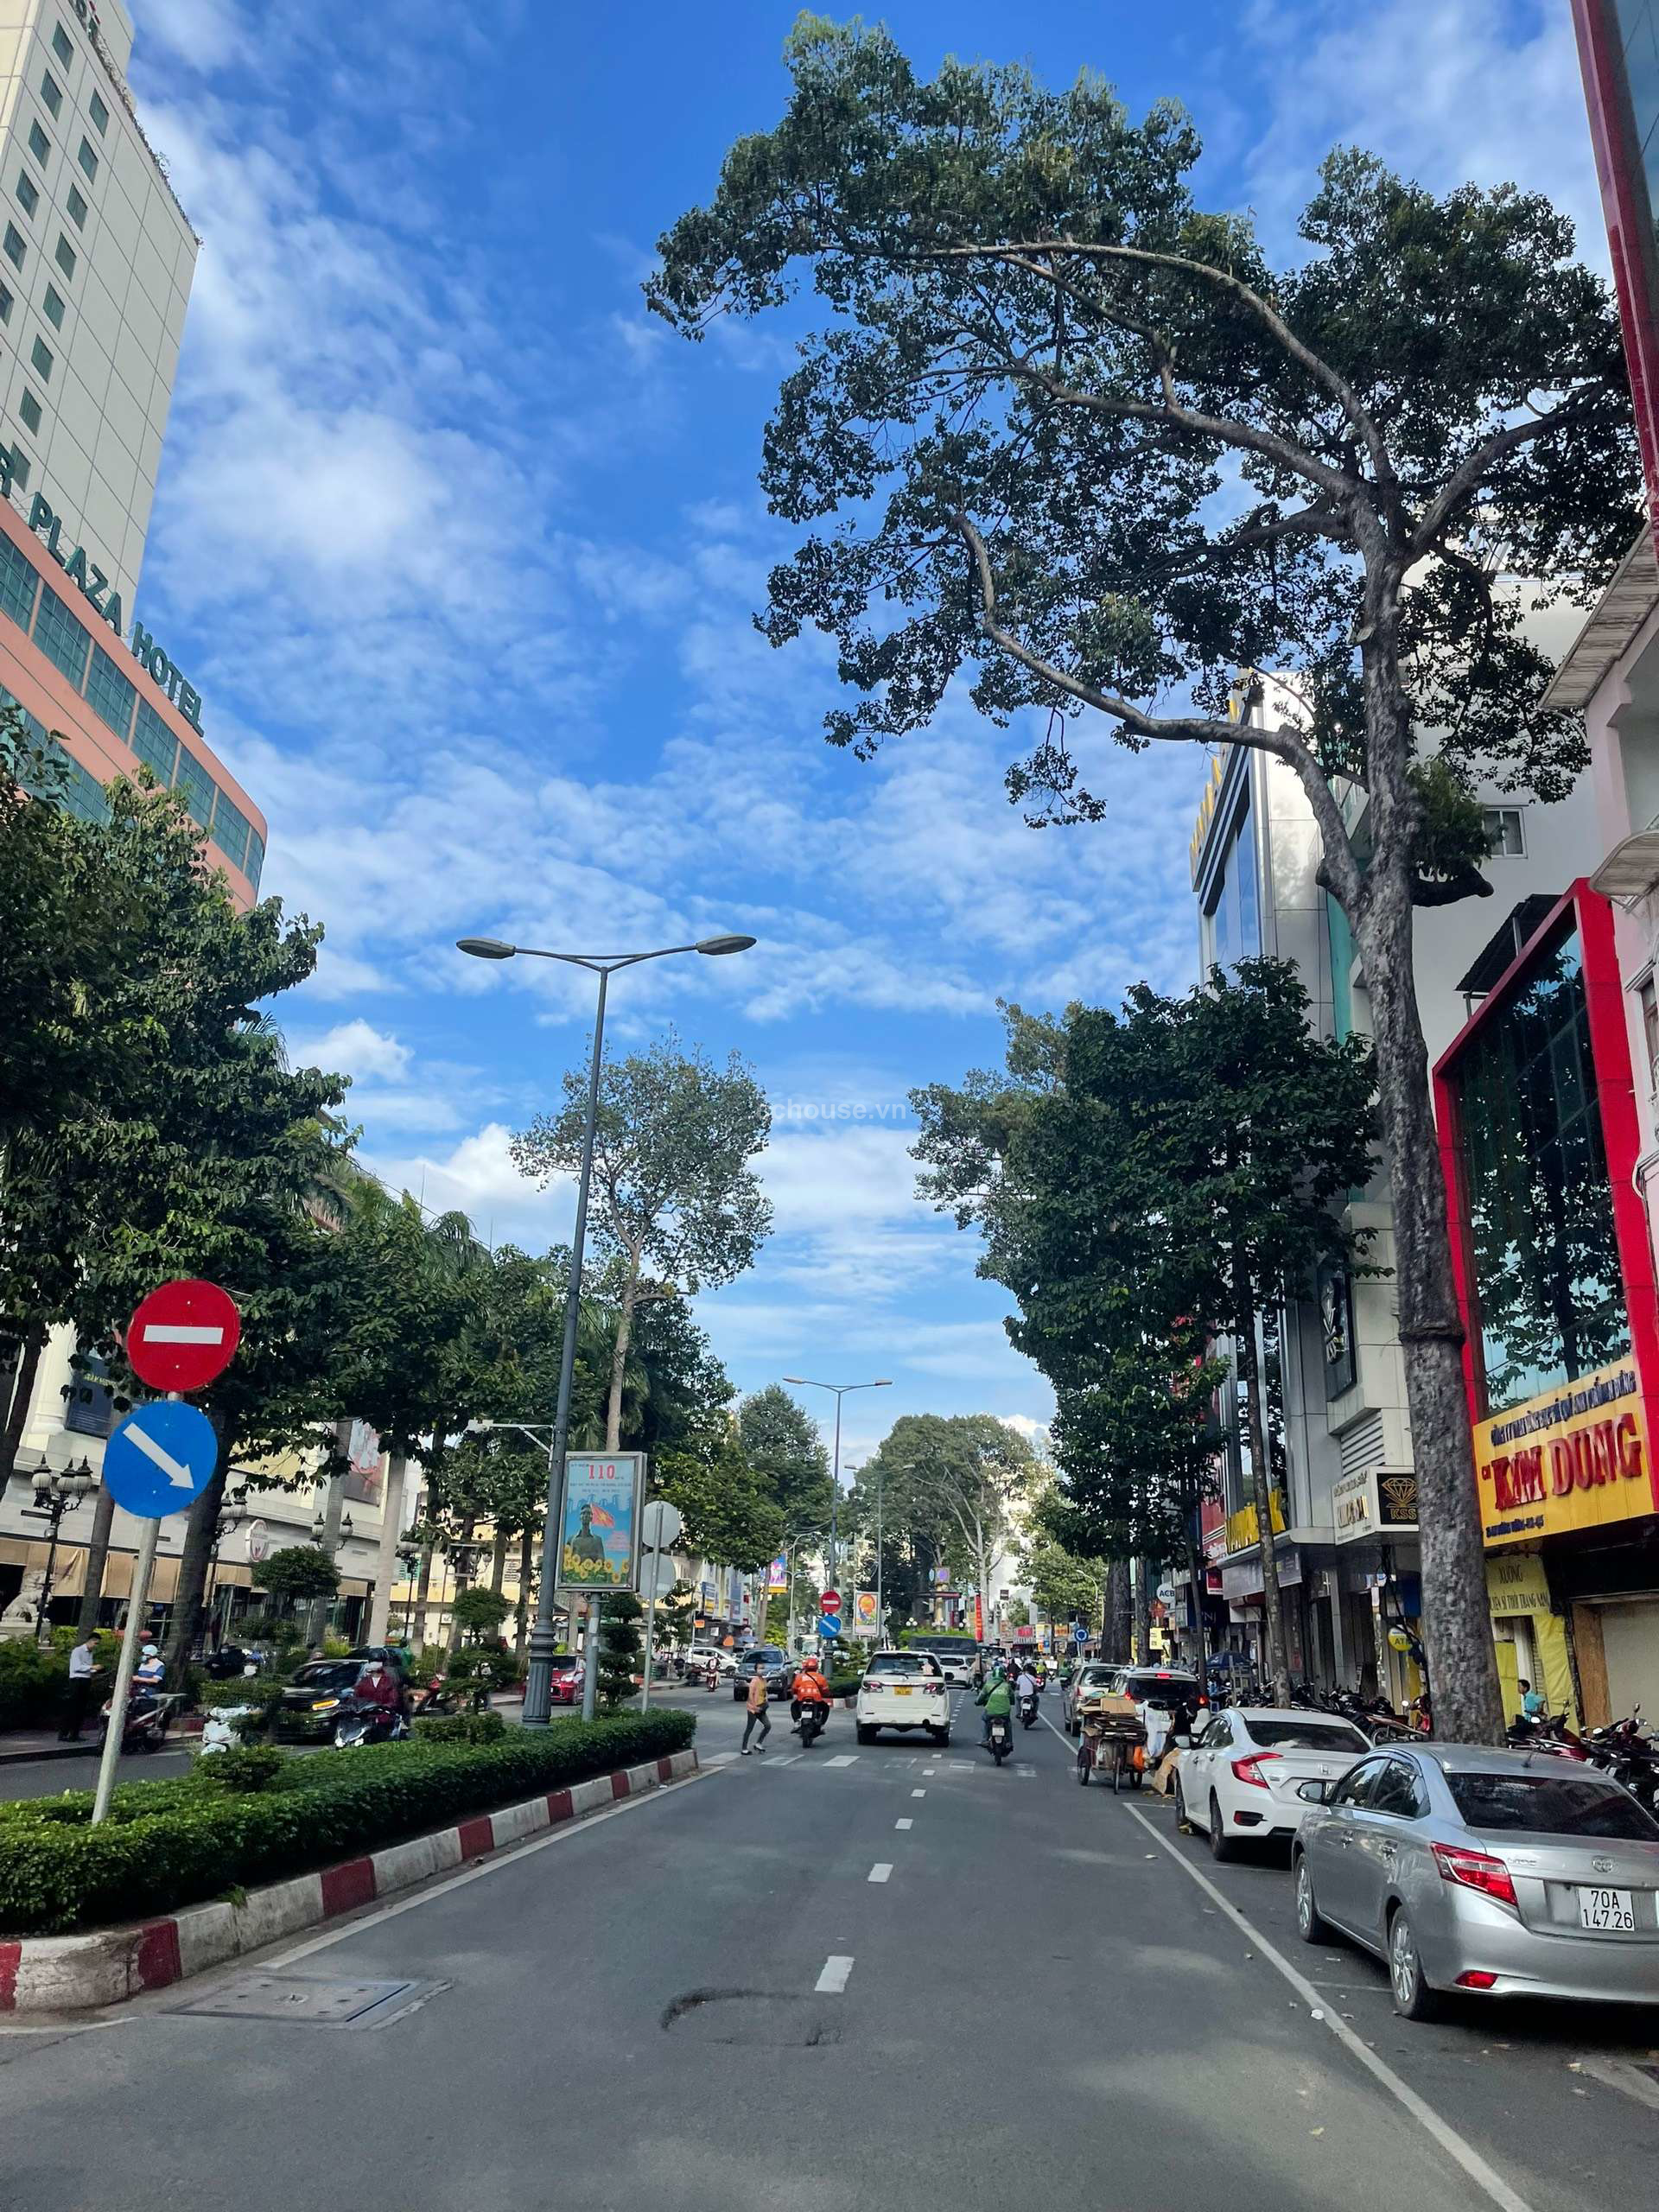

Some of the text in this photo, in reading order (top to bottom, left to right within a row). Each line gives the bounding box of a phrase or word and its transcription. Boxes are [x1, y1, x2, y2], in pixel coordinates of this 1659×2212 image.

[29, 492, 122, 637] PLAZA
[131, 620, 205, 738] HOTEL
[1548, 1412, 1643, 1497] DUNG
[588, 1465, 616, 1480] 110
[1389, 1508, 1417, 1520] KSS
[1591, 1890, 1620, 1910] 70A
[1583, 1909, 1633, 1929] 147.26
